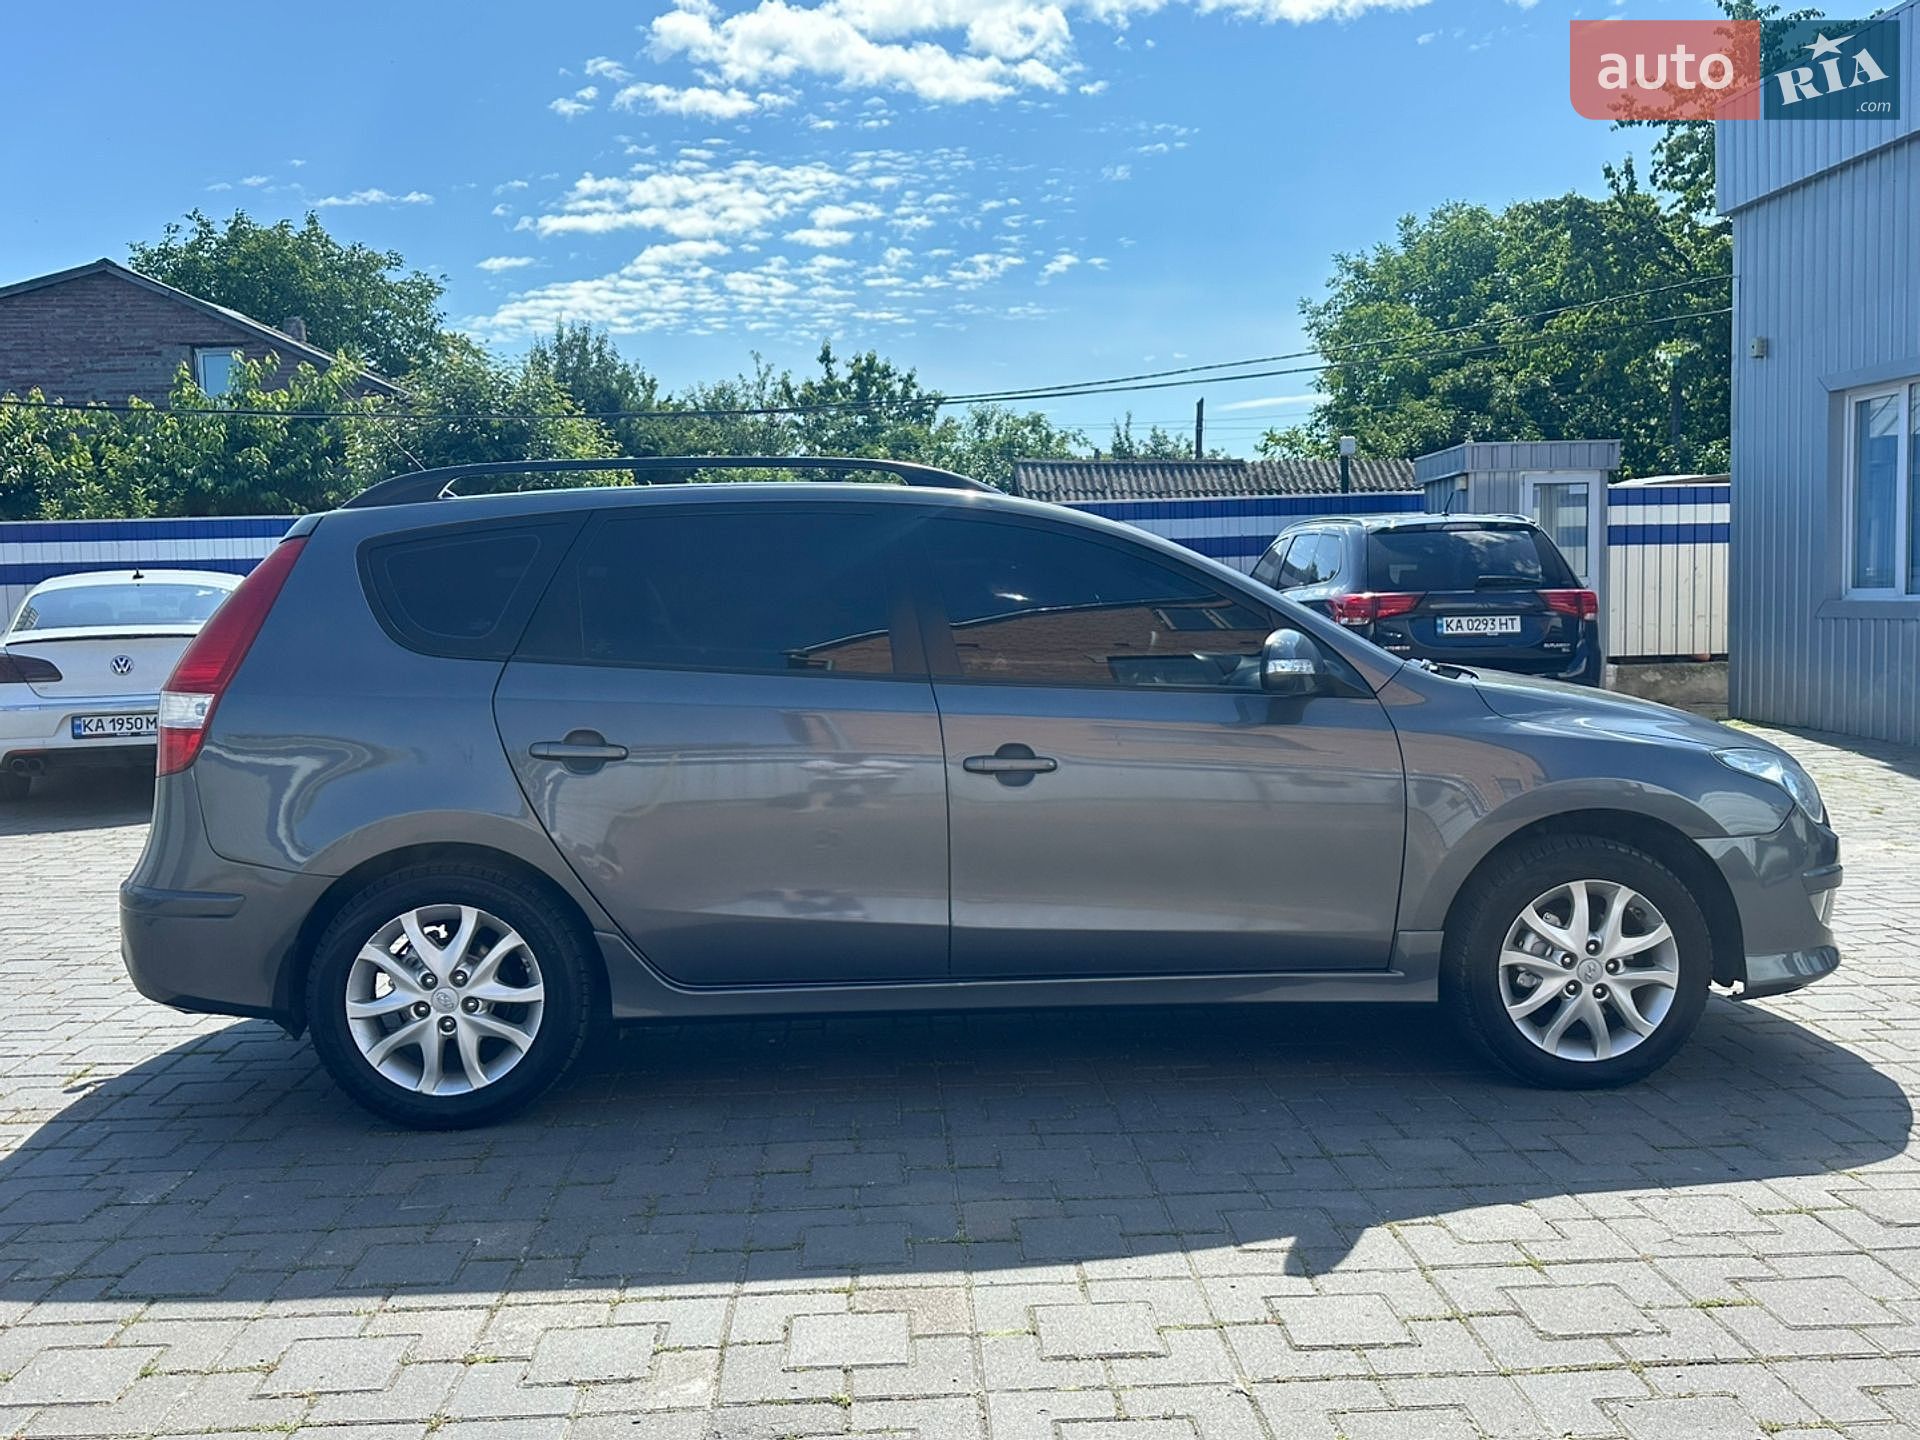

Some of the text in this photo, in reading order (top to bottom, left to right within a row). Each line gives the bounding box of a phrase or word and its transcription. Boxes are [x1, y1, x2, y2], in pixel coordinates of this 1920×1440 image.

[1445, 617, 1517, 632] KA 0293 HT
[82, 718, 106, 733] KA
[109, 717, 144, 732] 1950
